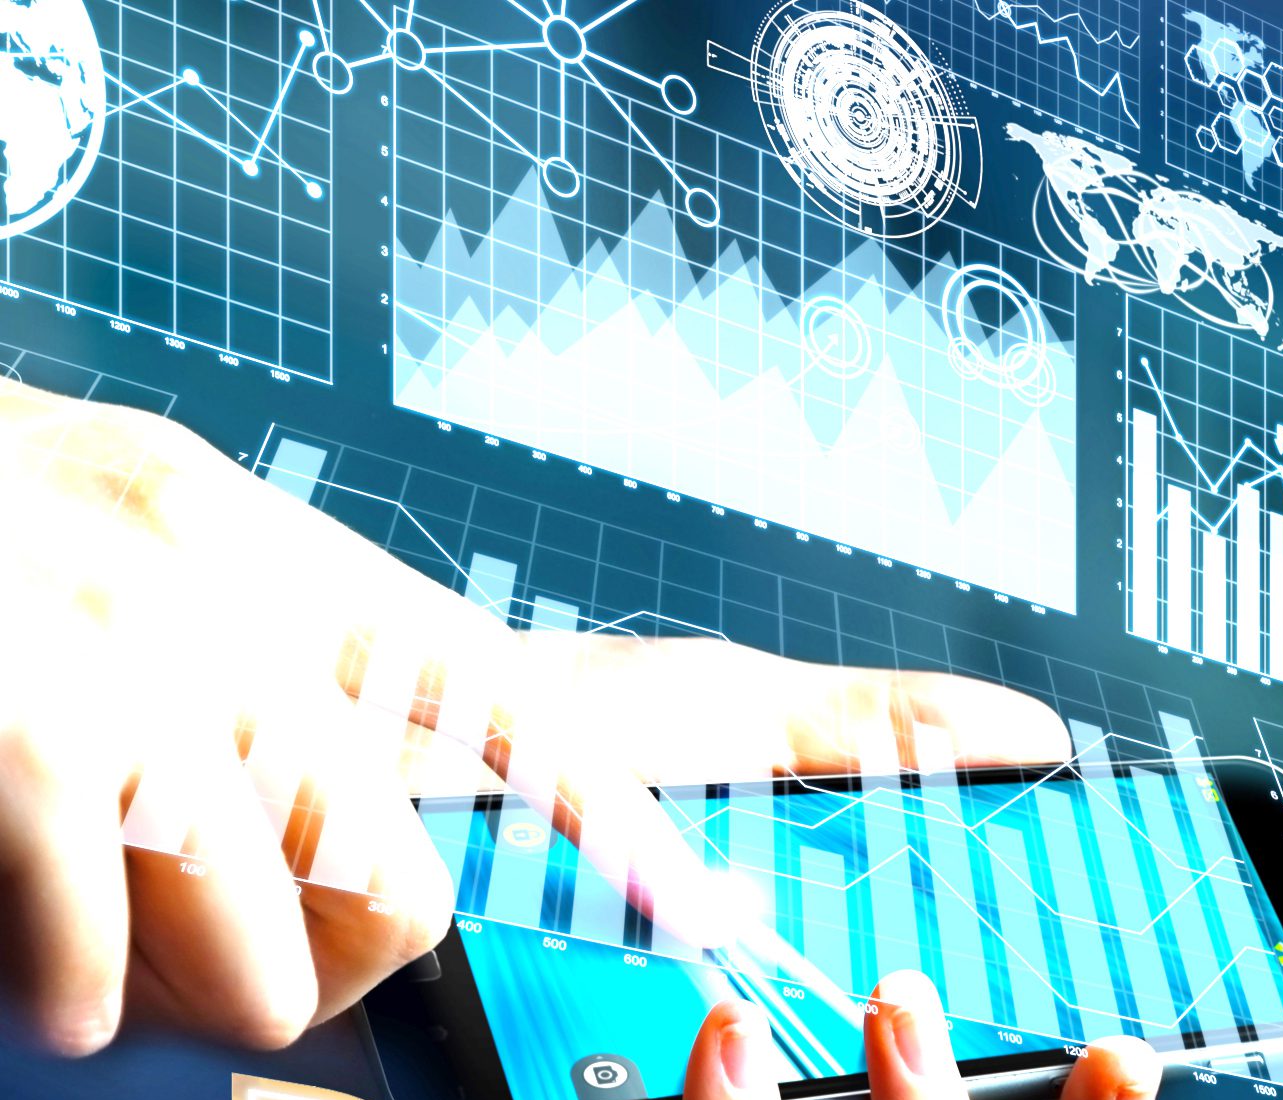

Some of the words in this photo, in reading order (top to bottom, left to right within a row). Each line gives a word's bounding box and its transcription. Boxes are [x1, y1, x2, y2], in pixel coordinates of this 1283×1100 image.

[380, 145, 389, 157] 5
[380, 195, 389, 207] 4
[380, 245, 389, 257] 3
[380, 293, 389, 304] 2
[0, 286, 19, 299] 000
[55, 303, 76, 317] 1100
[109, 319, 131, 333] 1200
[164, 335, 186, 350] 1300
[218, 353, 239, 367] 1400
[270, 369, 291, 382] 1500
[1116, 327, 1123, 337] 7
[381, 343, 388, 354] 1
[1116, 370, 1123, 380] 6
[1116, 412, 1123, 423] 5
[238, 451, 249, 462] 7
[1116, 455, 1123, 465] 4
[437, 420, 452, 432] 100
[711, 505, 725, 516] 700
[1116, 498, 1123, 508] 3
[1116, 539, 1123, 549] 2
[1116, 581, 1123, 591] 1
[1254, 749, 1262, 758] 7
[1270, 790, 1279, 800] 6
[179, 861, 206, 877] 100
[455, 919, 483, 934] 400
[542, 936, 567, 952] 500
[623, 953, 648, 968] 600
[782, 985, 805, 1000] 800
[997, 1030, 1023, 1046] 1100
[1063, 1044, 1089, 1059] 1200
[1192, 1071, 1217, 1086] 1400
[1253, 1083, 1277, 1098] 1500
